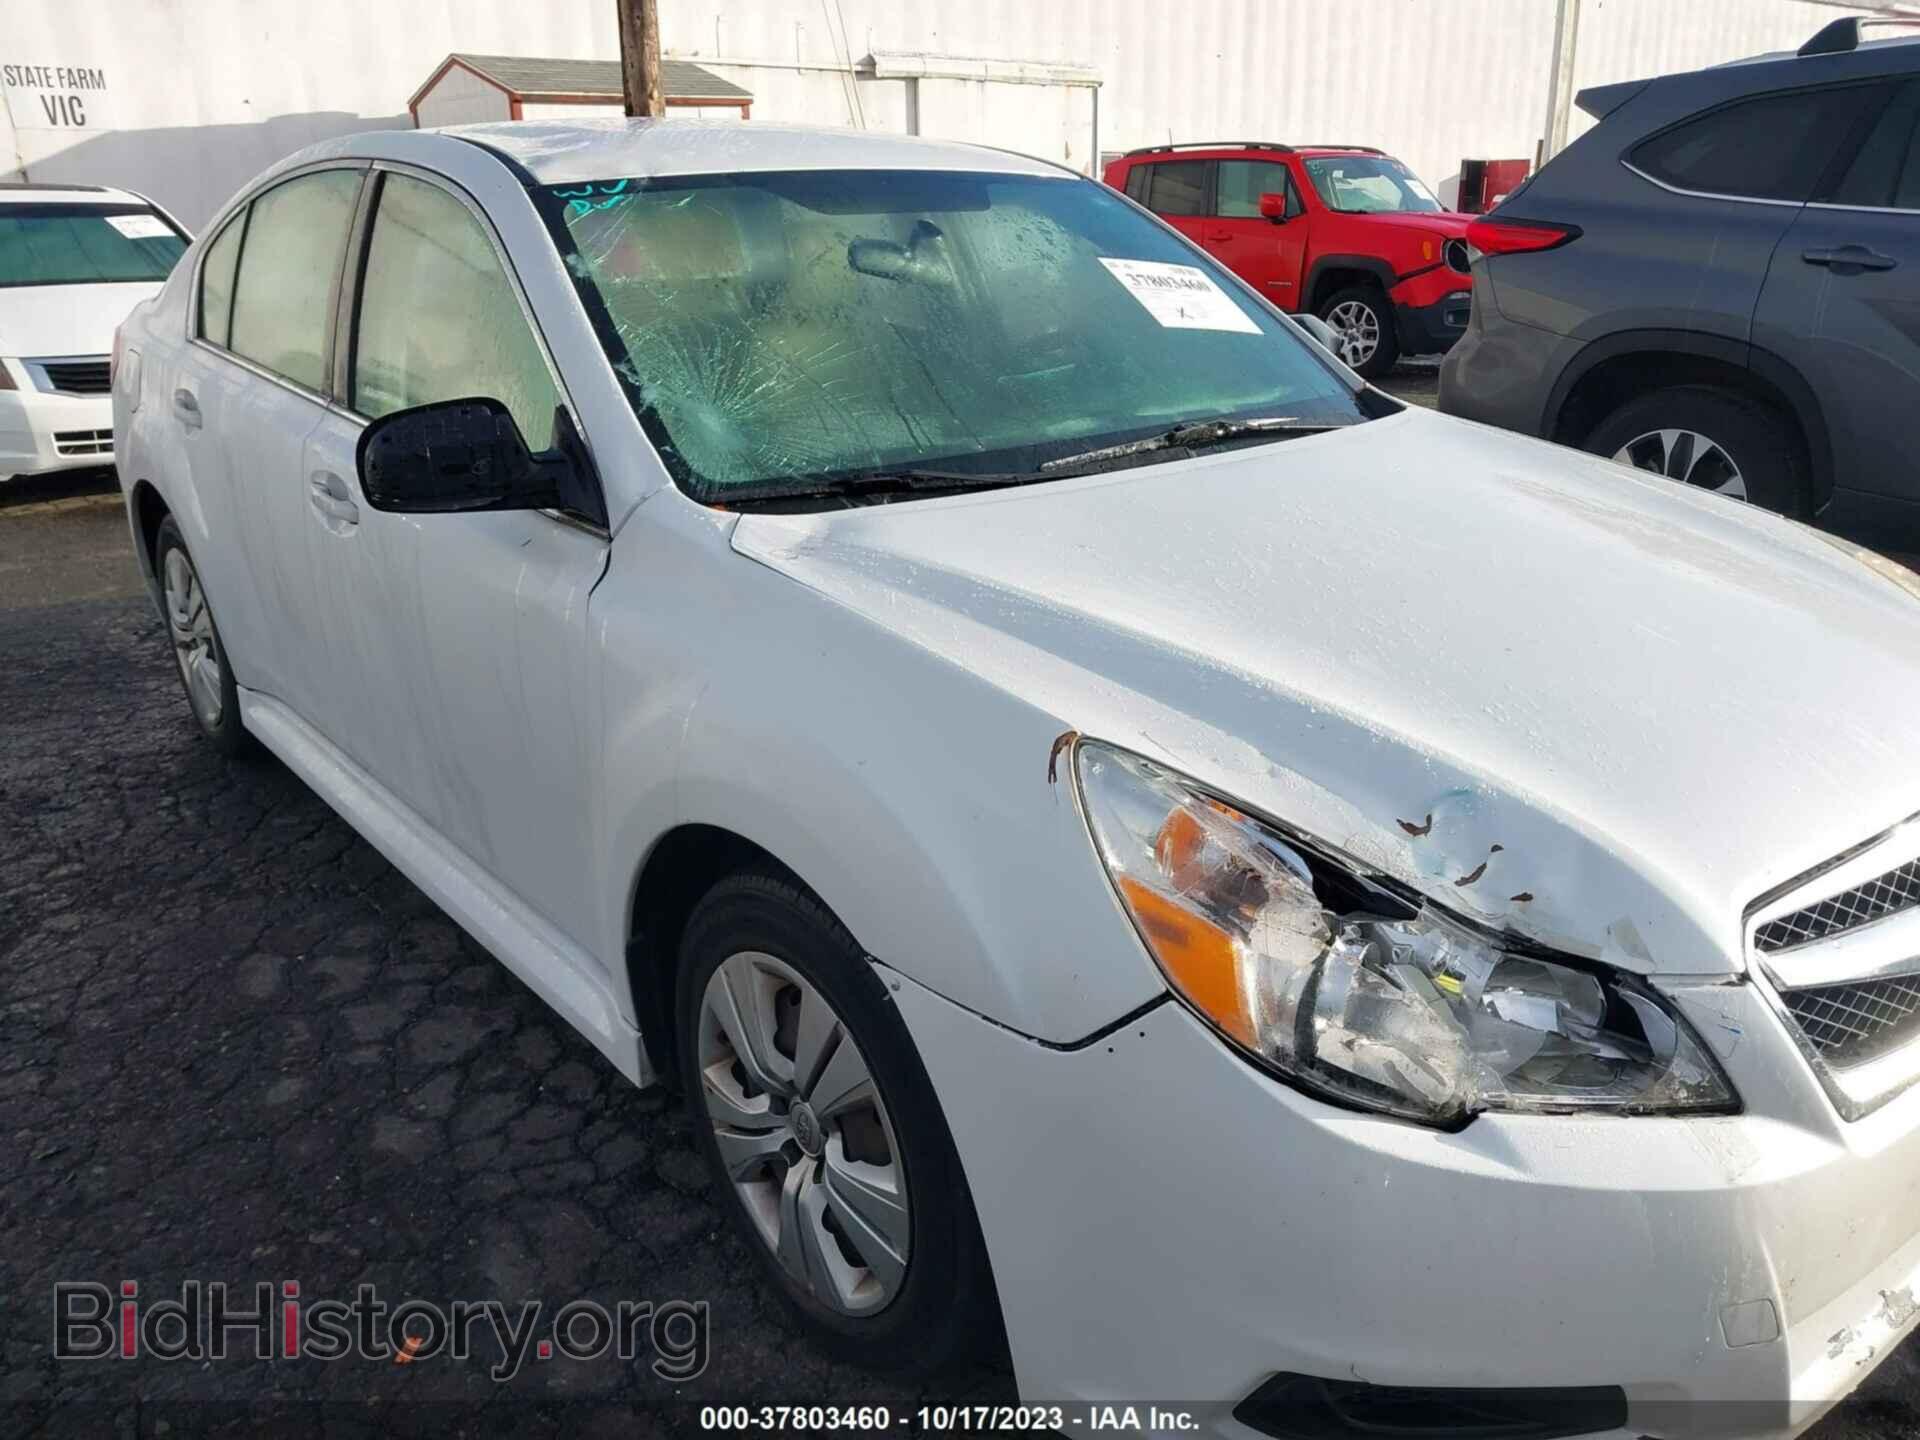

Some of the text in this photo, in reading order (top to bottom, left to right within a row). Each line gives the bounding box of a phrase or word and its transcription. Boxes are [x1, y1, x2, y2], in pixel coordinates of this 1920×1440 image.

[4, 65, 107, 90] STATE FARM
[40, 94, 86, 126] VIC
